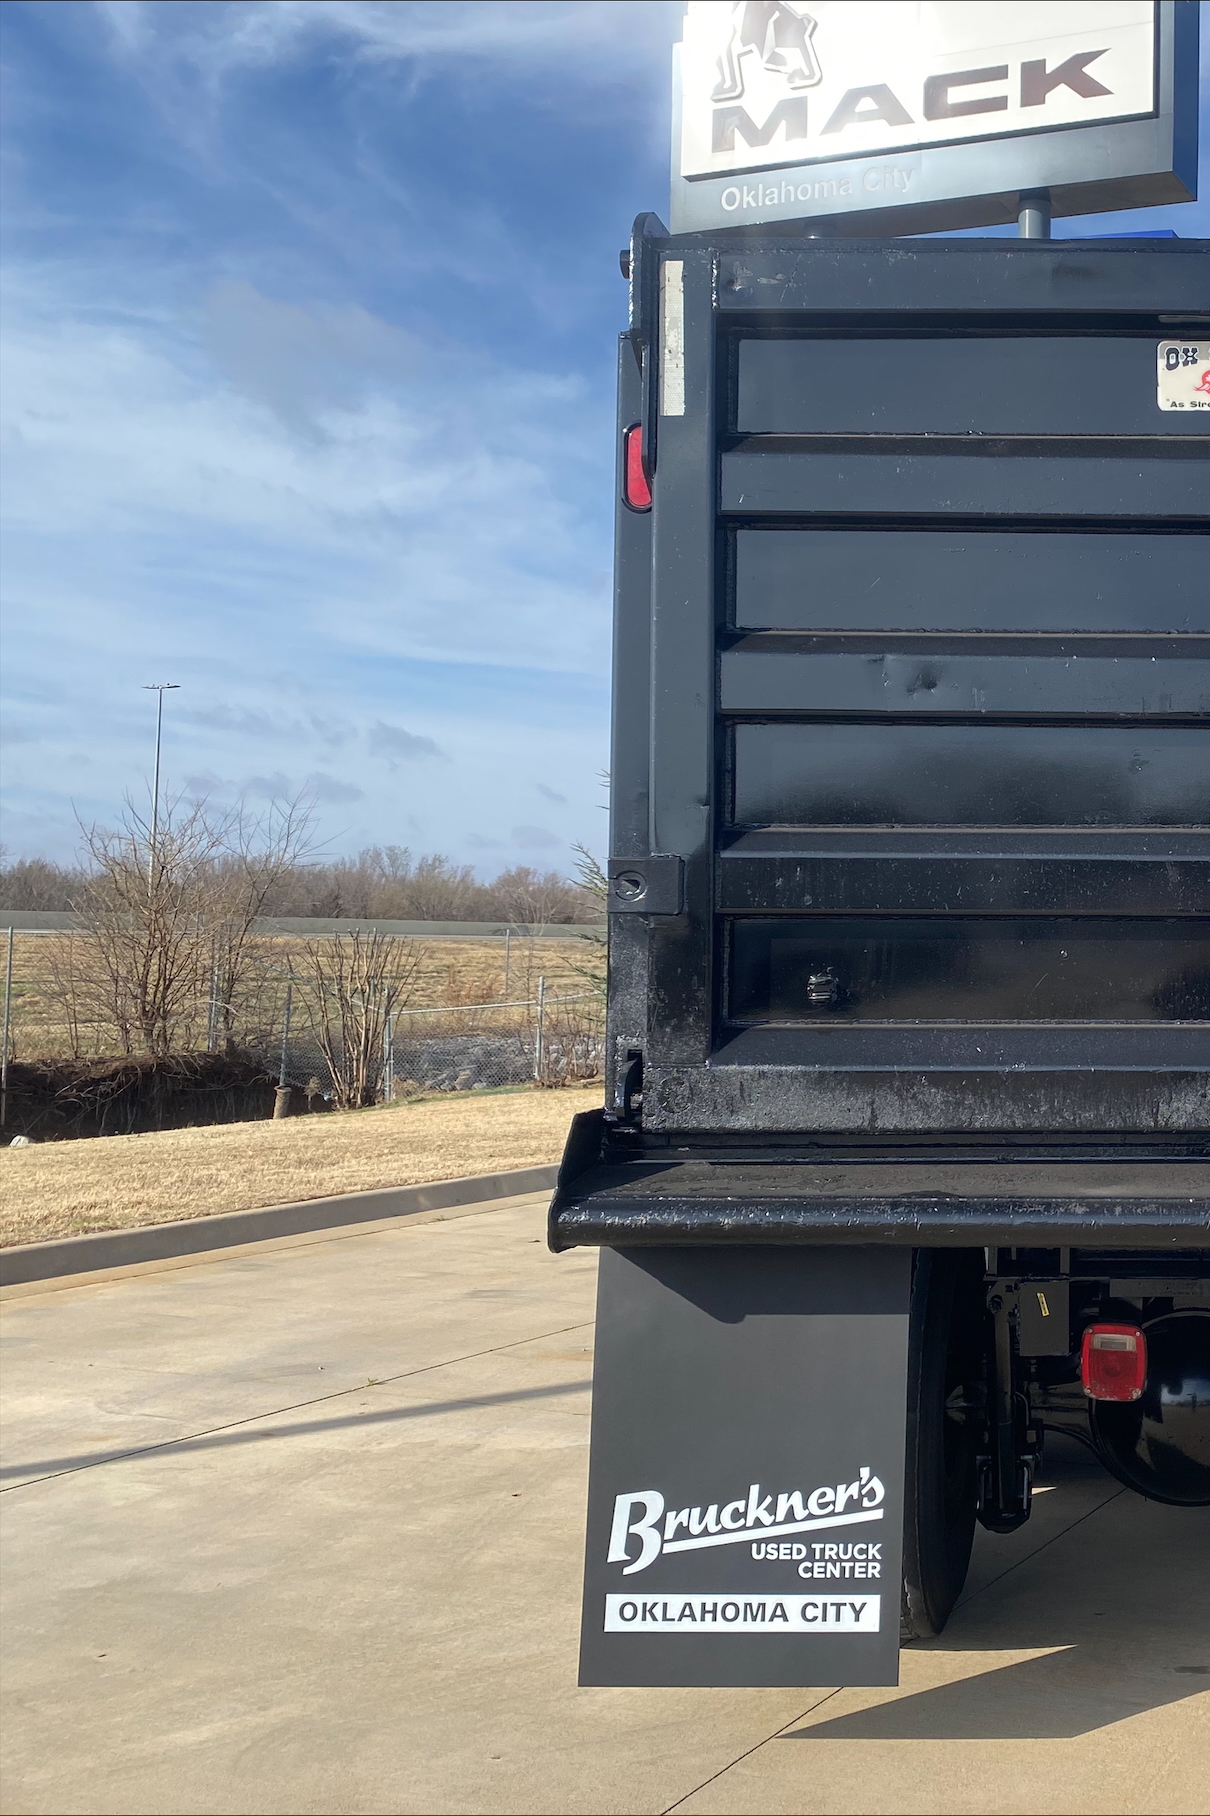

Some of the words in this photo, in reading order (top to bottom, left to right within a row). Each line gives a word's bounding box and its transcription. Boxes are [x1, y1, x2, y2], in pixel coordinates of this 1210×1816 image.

[712, 48, 1114, 153] MACK
[721, 177, 852, 211] Oklahoma
[863, 165, 915, 193] City
[1165, 347, 1198, 371] OX
[607, 1466, 885, 1575] Bruckner's
[751, 1543, 806, 1560] USED
[811, 1543, 882, 1560] TRUCK
[798, 1562, 881, 1578] CENTER
[618, 1601, 789, 1623] OKLAHOMA
[800, 1601, 867, 1622] CITY
